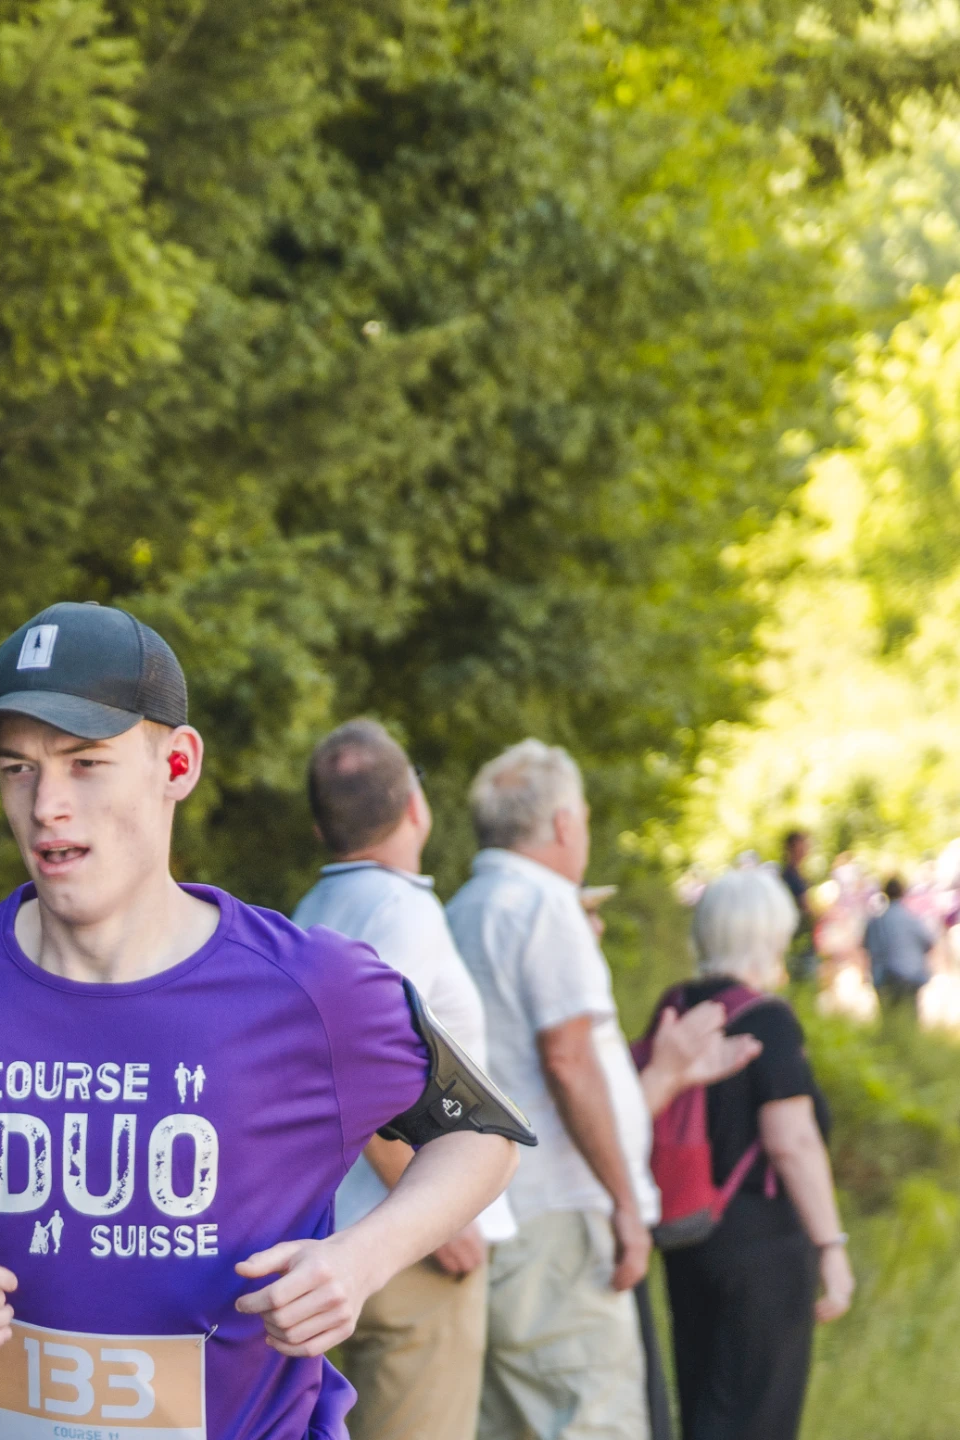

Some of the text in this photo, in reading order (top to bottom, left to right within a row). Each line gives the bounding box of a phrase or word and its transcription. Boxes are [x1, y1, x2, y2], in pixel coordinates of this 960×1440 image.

[90, 1223, 219, 1257] SUISSE
[24, 1336, 156, 1420] 133
[53, 1426, 102, 1440] COURSE
